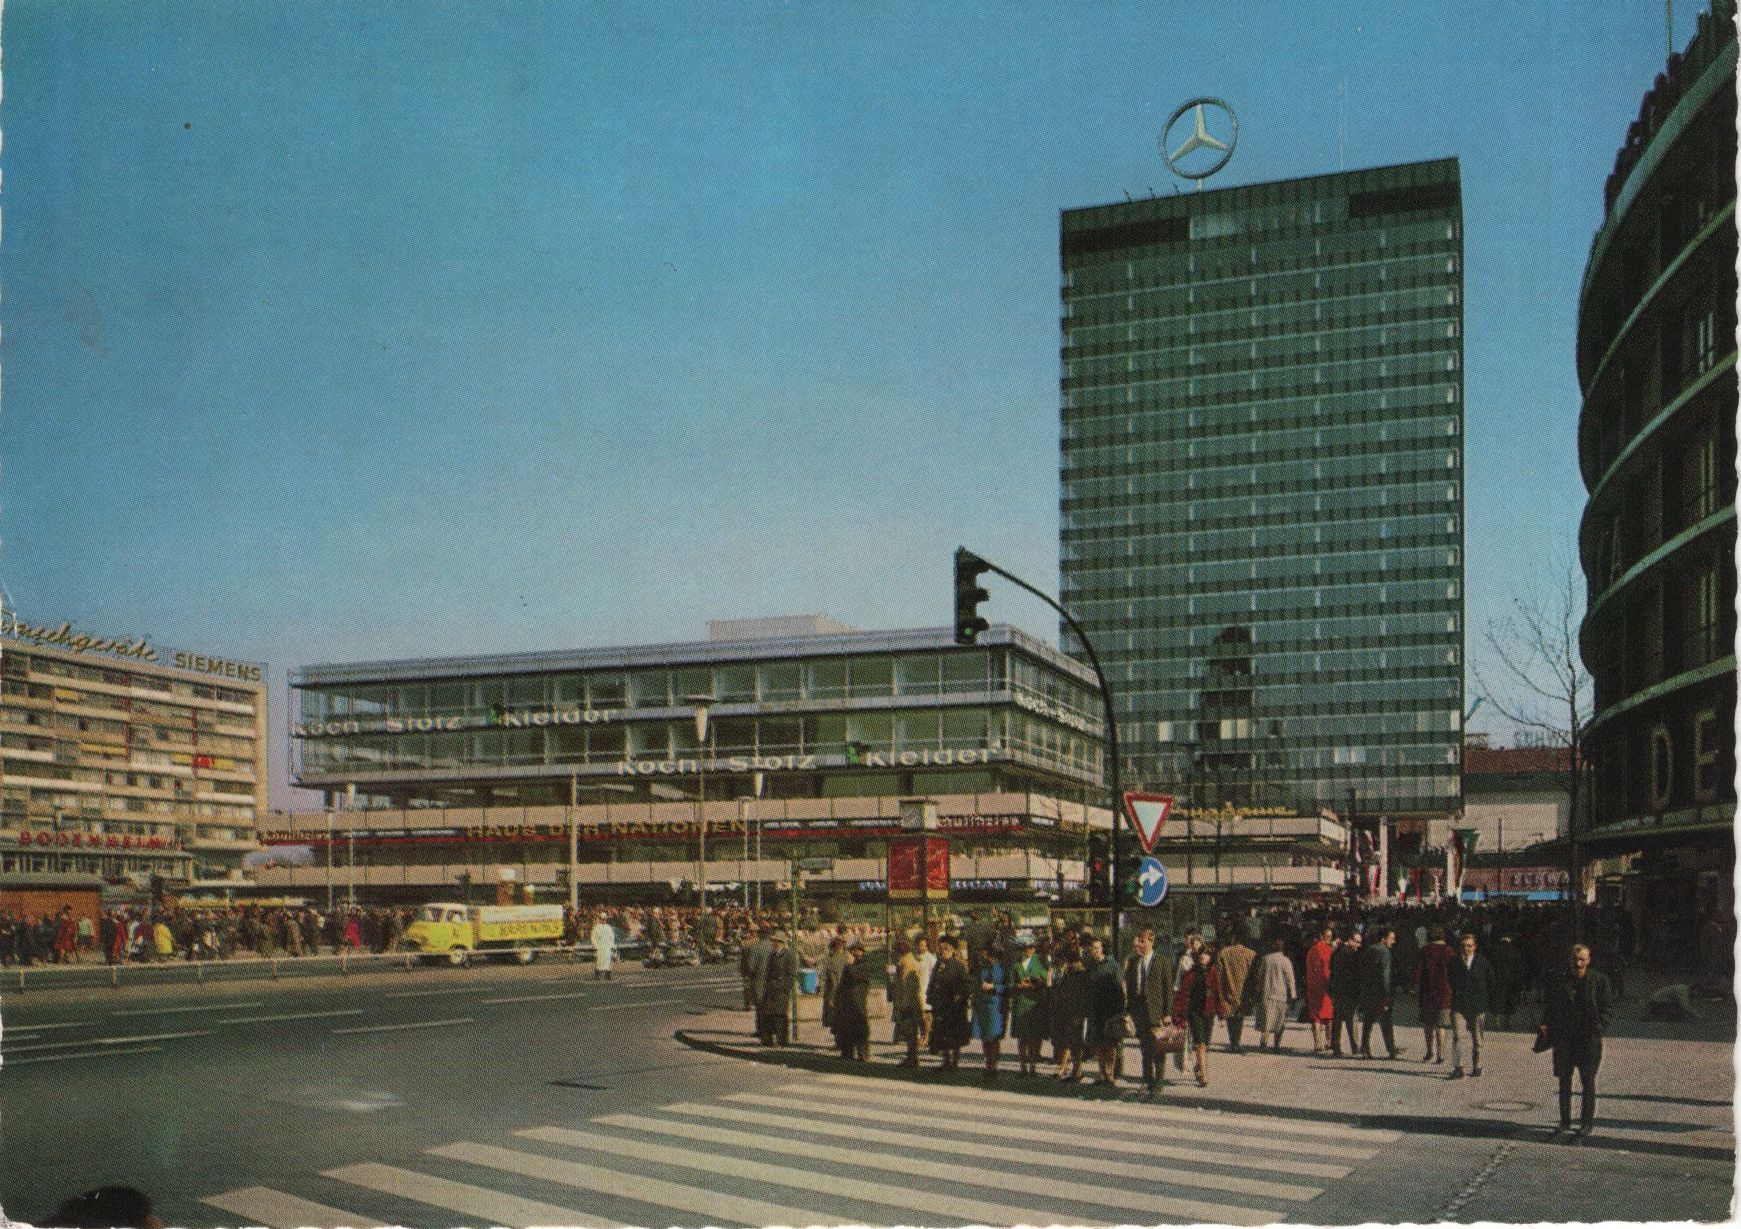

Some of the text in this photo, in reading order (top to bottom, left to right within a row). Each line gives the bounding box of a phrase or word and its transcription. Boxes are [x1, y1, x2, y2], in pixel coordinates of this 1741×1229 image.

[175, 652, 261, 682] SIEMENS
[617, 758, 698, 776] Koch
[866, 747, 990, 767] Kleider
[547, 824, 598, 837] DR
